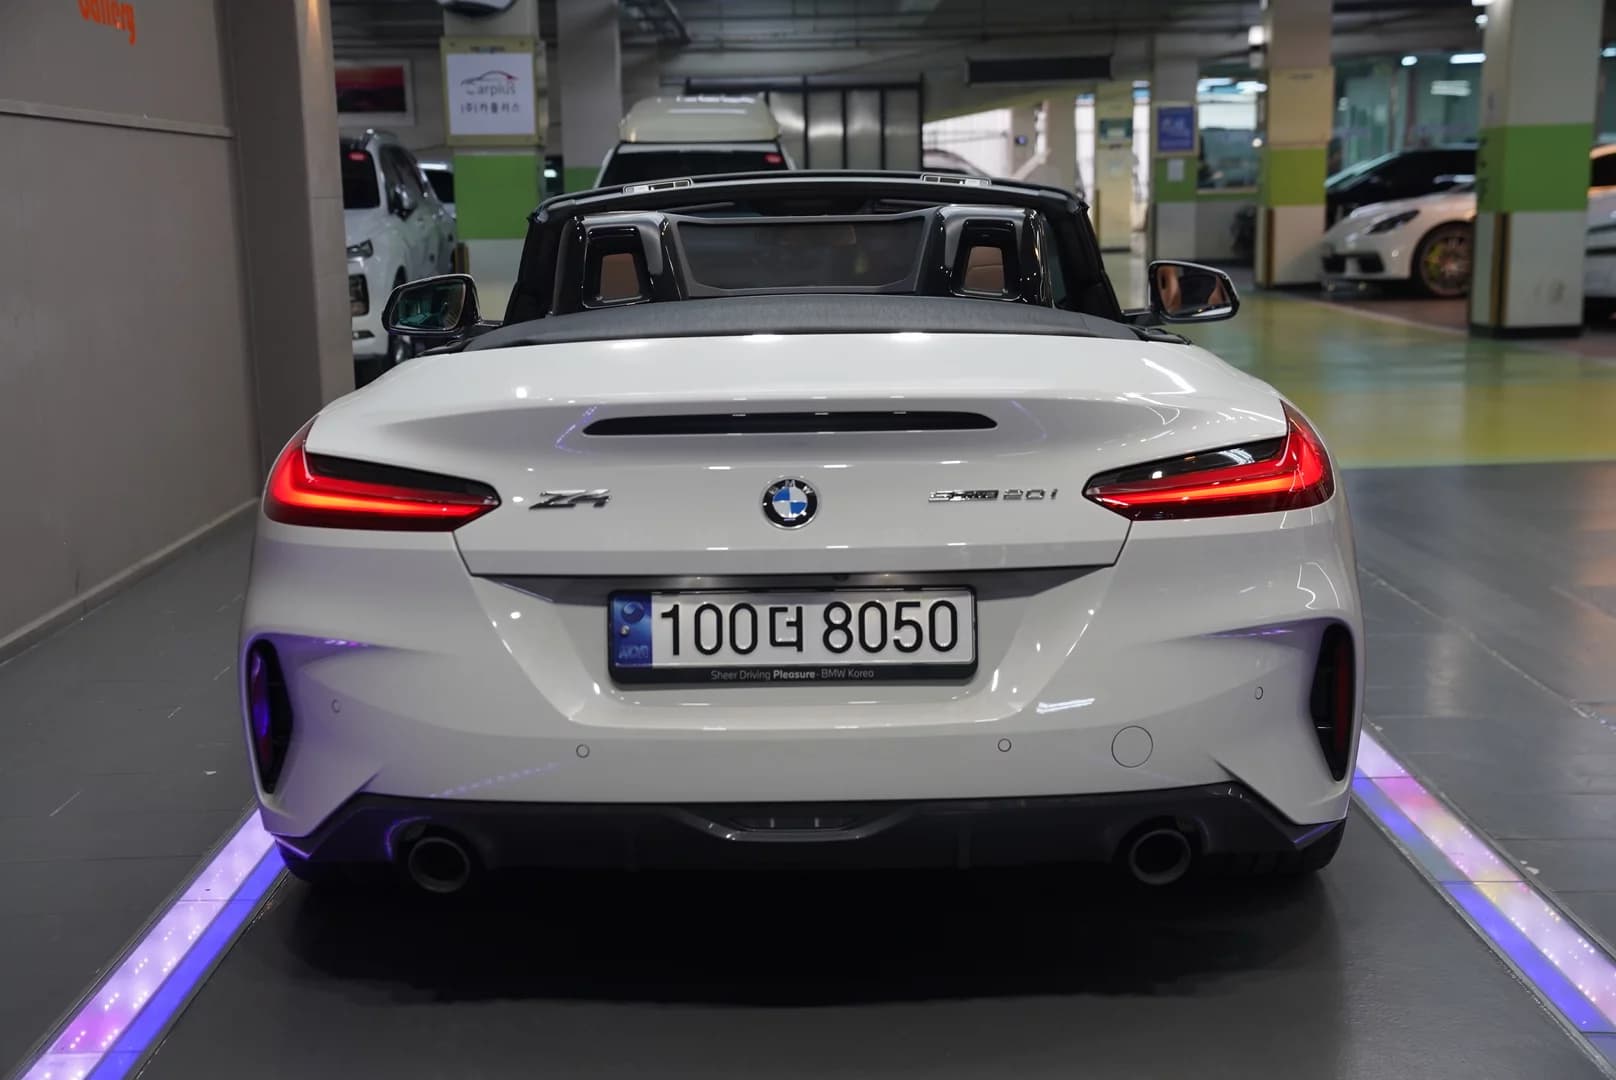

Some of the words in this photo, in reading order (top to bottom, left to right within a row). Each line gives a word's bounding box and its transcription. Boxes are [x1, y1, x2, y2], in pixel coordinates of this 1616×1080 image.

[528, 488, 611, 510] Z4
[661, 602, 804, 657] 100더
[823, 600, 959, 655] 8050
[711, 670, 737, 681] Sheer
[739, 670, 771, 681] Driving
[773, 669, 816, 680] Pleasure
[821, 668, 845, 679] BMW
[848, 668, 875, 679] Korea
